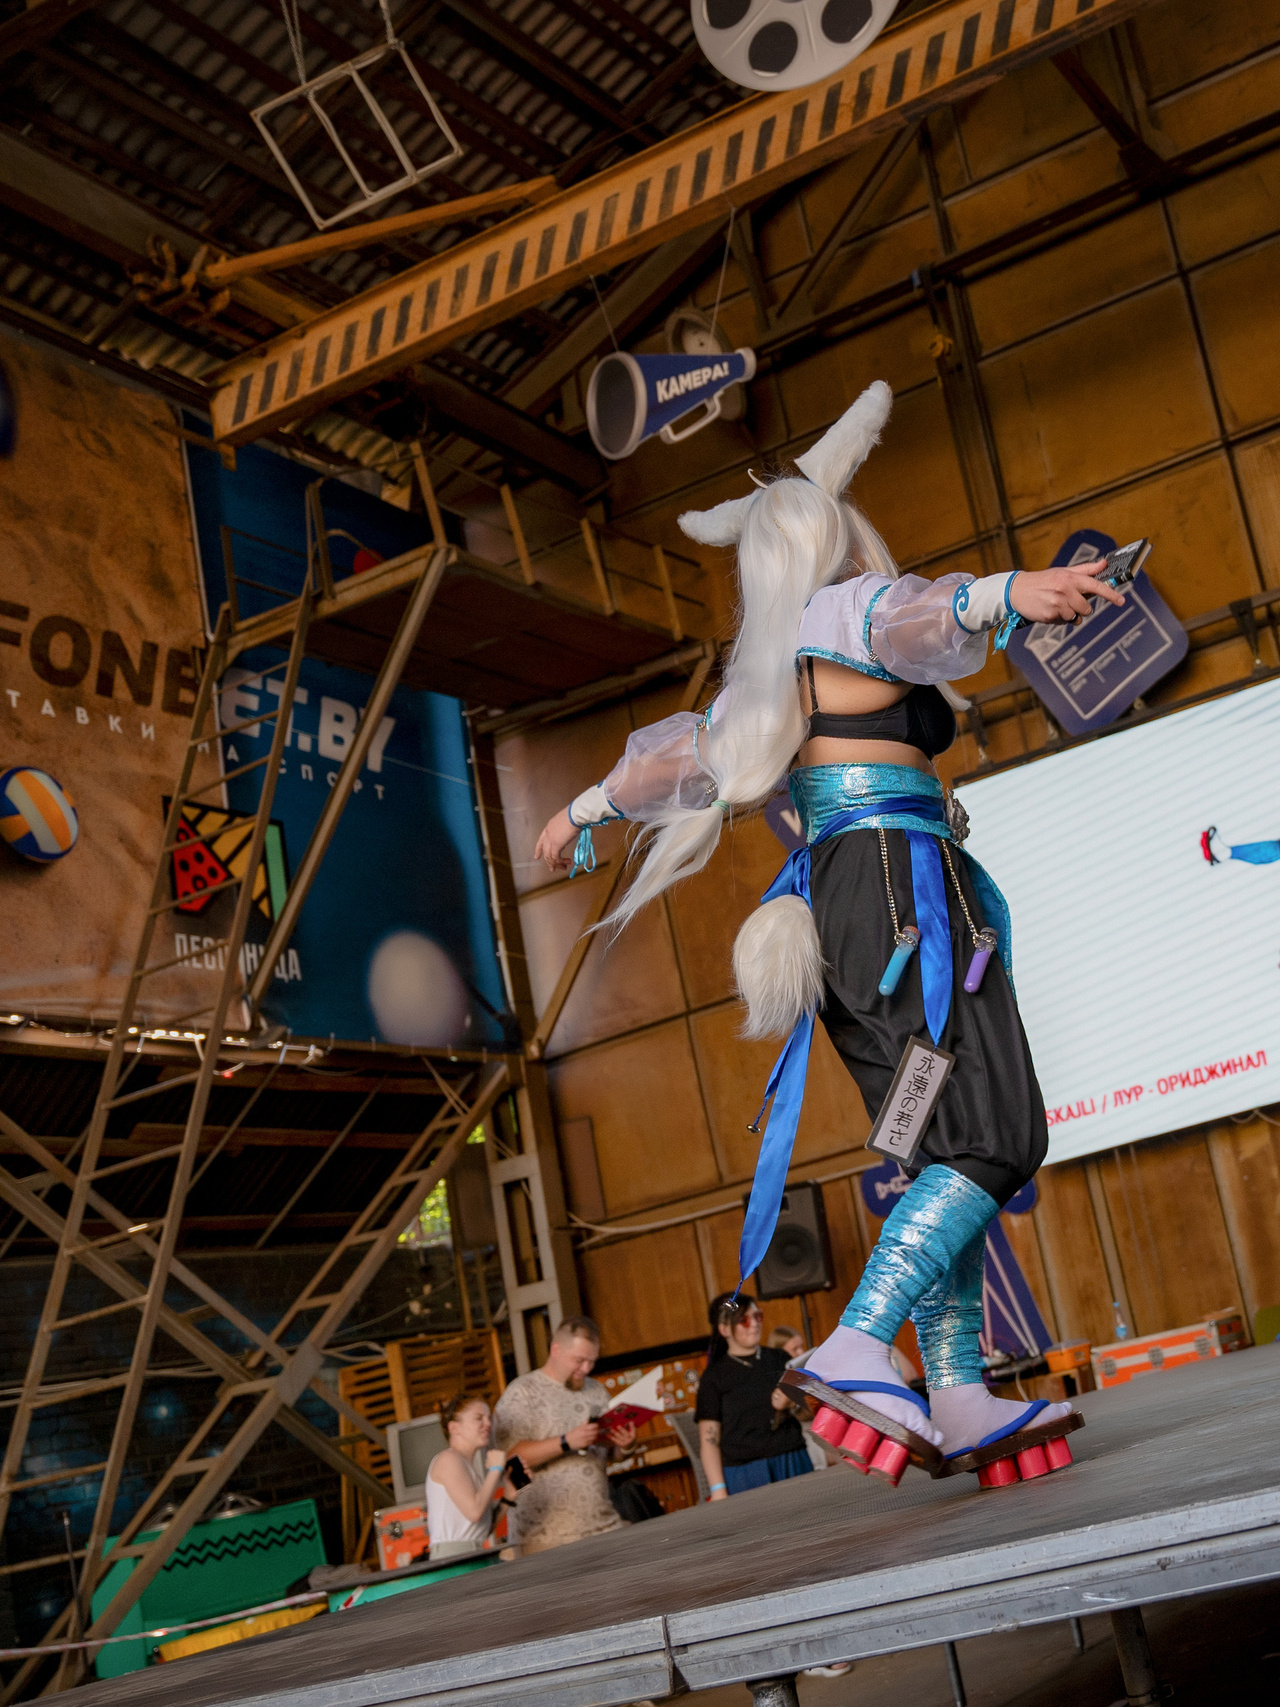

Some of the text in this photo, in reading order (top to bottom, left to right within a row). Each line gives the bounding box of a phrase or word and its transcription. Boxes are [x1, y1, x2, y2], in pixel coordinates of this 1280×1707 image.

[655, 361, 731, 404] КАМЕРА!
[888, 1054, 937, 1147] 永遠の若さ
[1113, 1084, 1144, 1108] ЛУР
[1156, 1049, 1268, 1095] ОРИДЖИНАЛ
